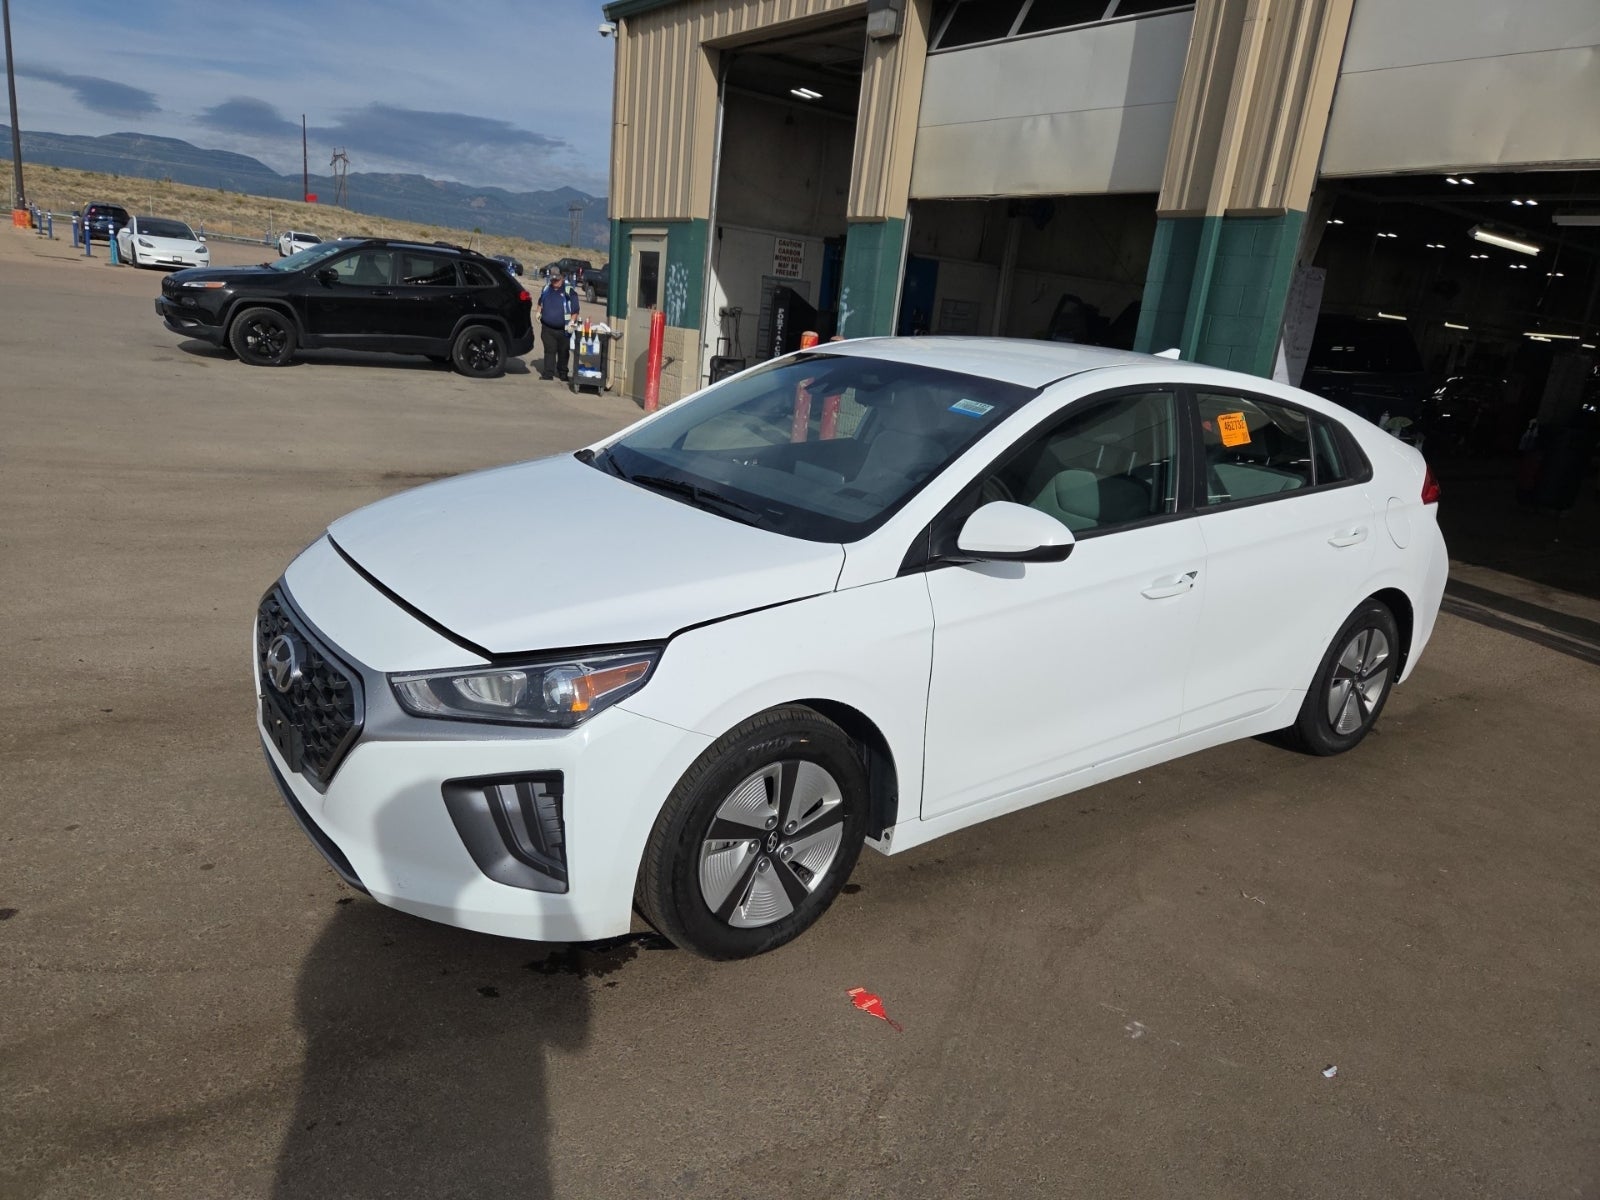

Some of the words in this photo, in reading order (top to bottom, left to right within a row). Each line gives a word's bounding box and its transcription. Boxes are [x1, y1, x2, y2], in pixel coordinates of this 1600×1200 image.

[778, 239, 802, 248] CAUTION
[778, 247, 800, 256] CARBON
[775, 255, 802, 263] MONOXIDE
[775, 268, 799, 277] PRESENT
